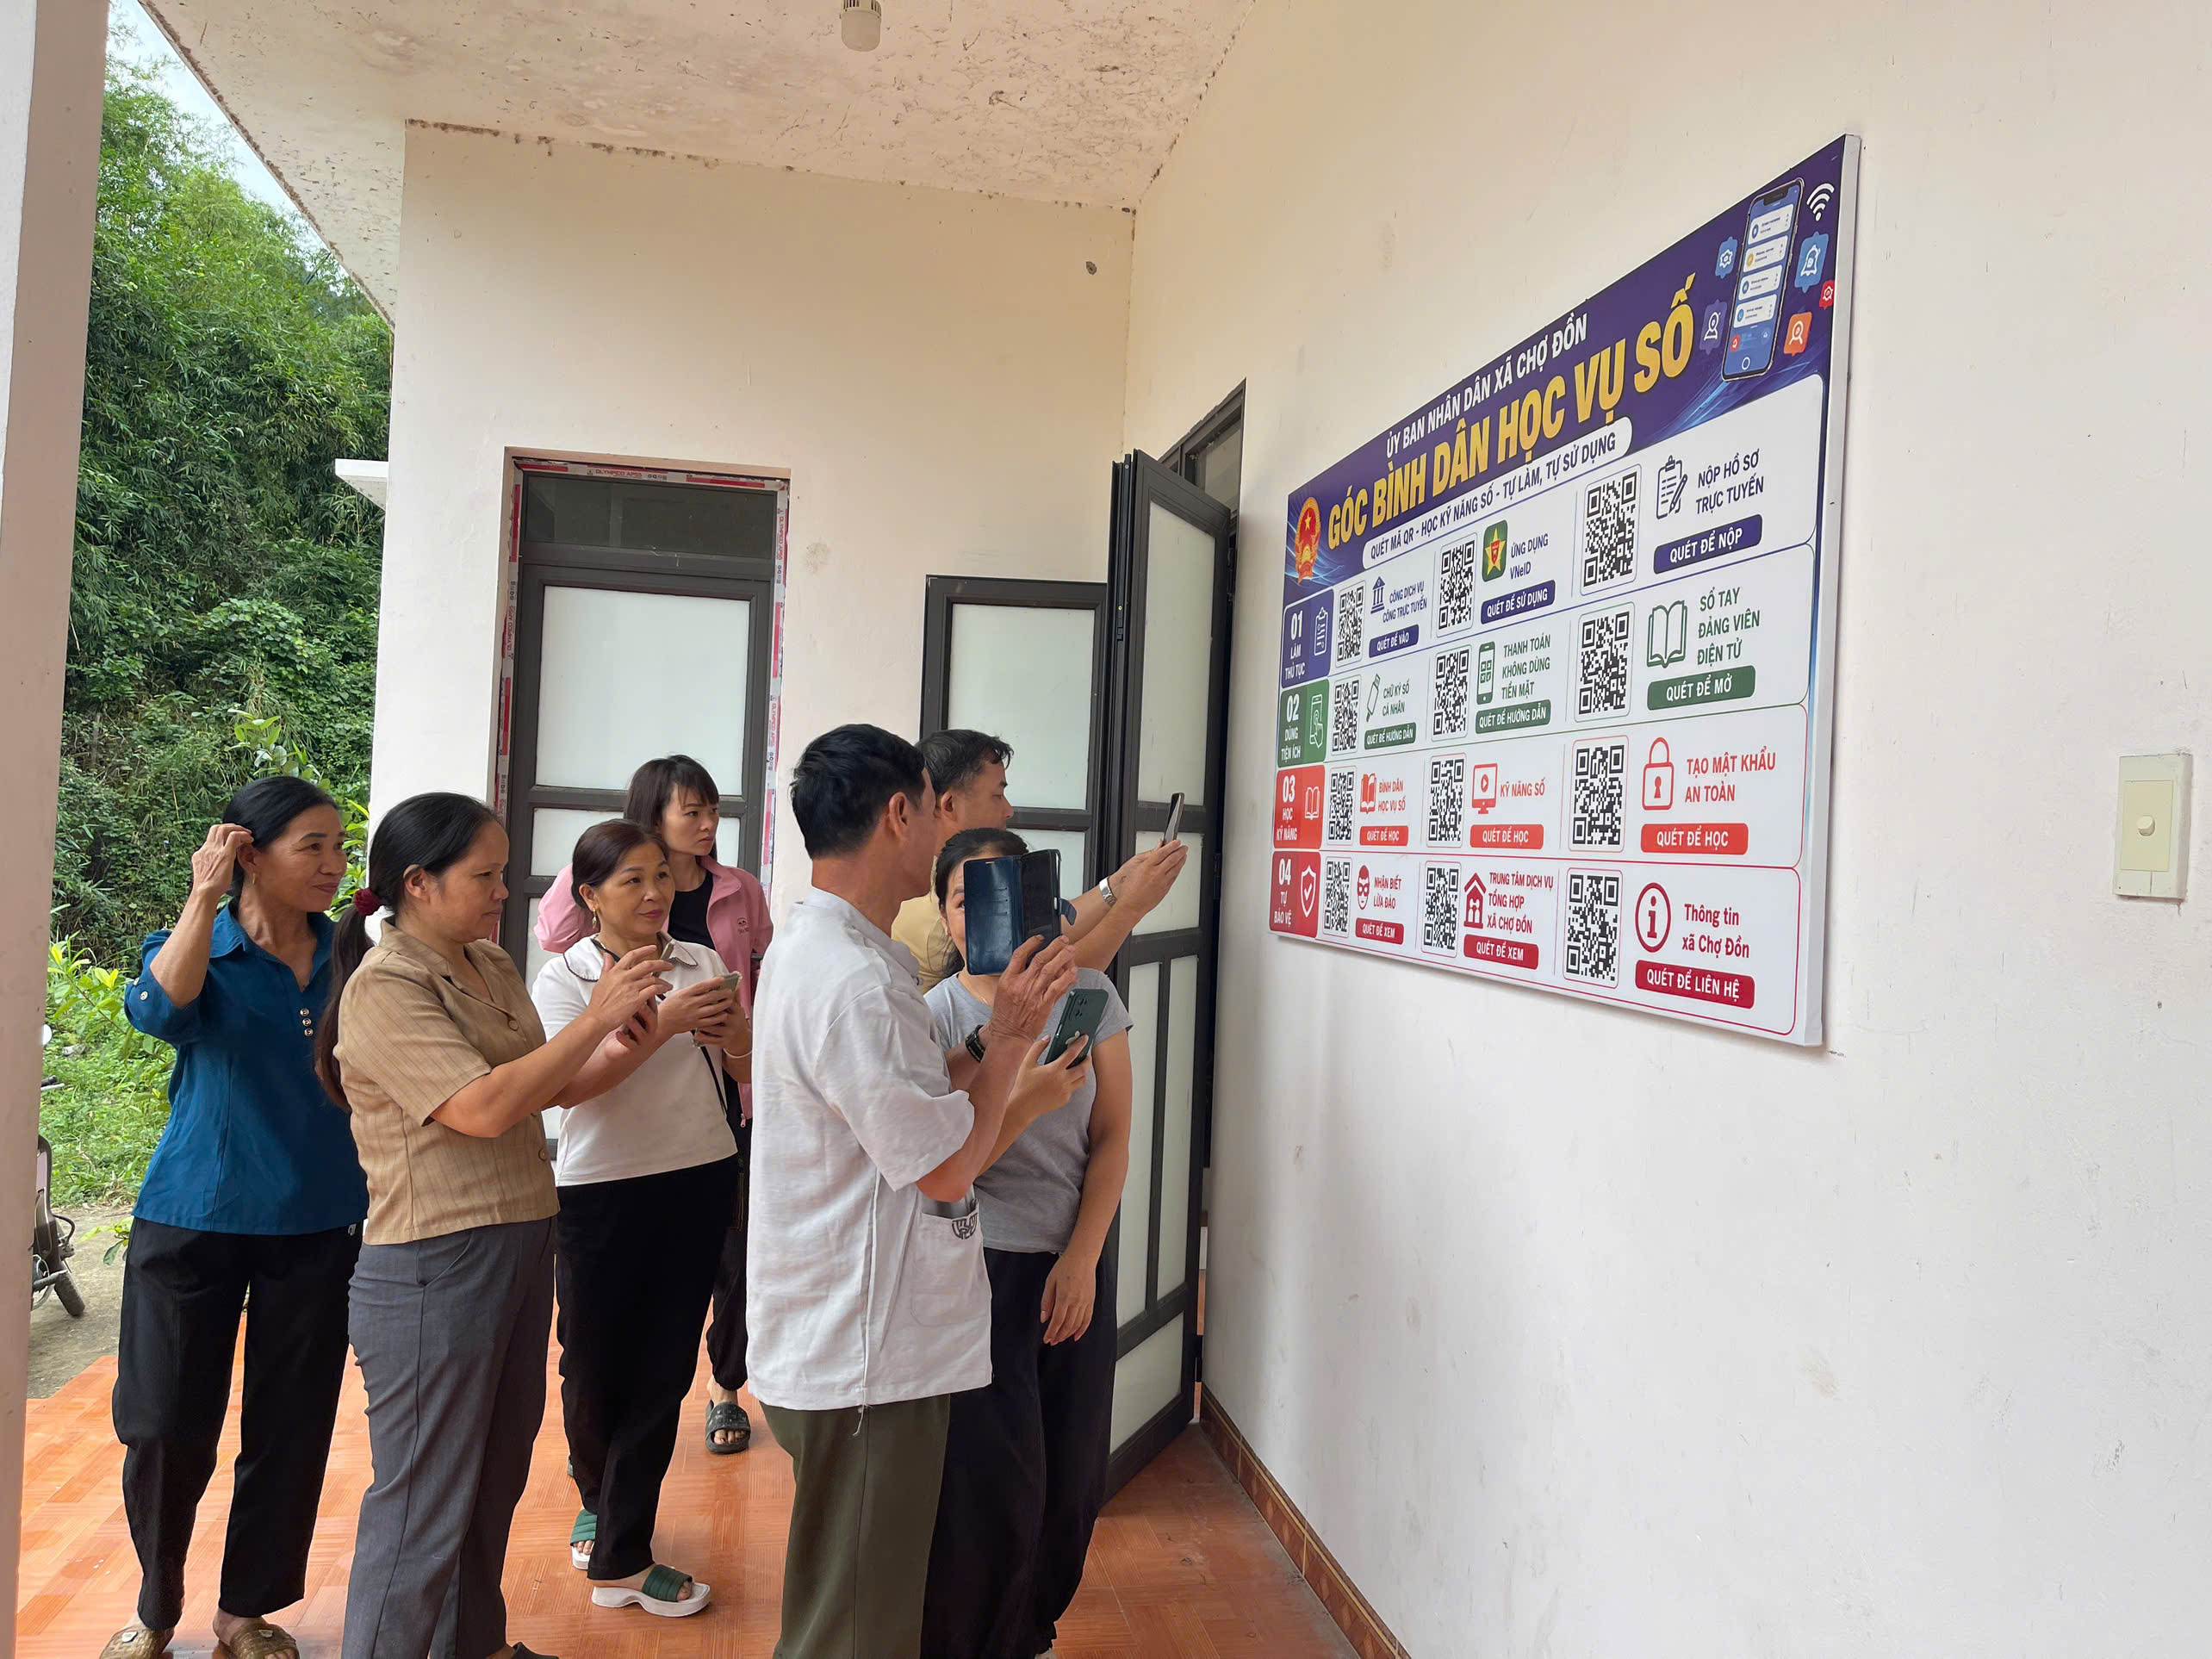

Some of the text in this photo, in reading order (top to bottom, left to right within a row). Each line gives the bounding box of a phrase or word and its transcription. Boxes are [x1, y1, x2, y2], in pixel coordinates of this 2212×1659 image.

[1386, 312, 1588, 458] ỦY BAN NHÂN DÂN XÃ CHỢ ĐỒN
[1328, 272, 1696, 550] GÓC BÌNH DÂN HỌC VỤ SỐ
[1698, 449, 1760, 488] NỘP HỒ SƠ
[1370, 537, 1389, 560] QUÉT
[1390, 527, 1401, 552] MÃ
[1403, 527, 1414, 544] QR
[1421, 515, 1438, 537] HỌC
[1439, 506, 1451, 527] KỸ
[1453, 497, 1478, 522] NĂNG
[1481, 482, 1494, 509] SỐ
[1503, 479, 1517, 503] TỰ
[1518, 468, 1543, 493] LÀM,
[1546, 459, 1562, 482] TỰ
[1563, 444, 1580, 471] SỬ
[1581, 435, 1616, 463] DỤNG
[1696, 474, 1764, 514] TRỰC TUYẾN
[1527, 533, 1549, 553] DỤNG
[1669, 527, 1743, 563] QUÉT ĐỂ NỘP
[1510, 562, 1532, 580] VNeID
[1487, 587, 1548, 618] QUÉT ĐỂ SỬ DỤNG
[1699, 587, 1740, 612] SỔ TAY
[1290, 610, 1303, 640] 01
[1698, 608, 1761, 639] ĐẢNG VIÊN
[1504, 632, 1550, 658] THANH TOÁN
[1697, 637, 1743, 667] ĐIỆN TỬ
[1502, 656, 1550, 680] KHÔNG DÙNG
[1519, 680, 1534, 699] MẶT
[1666, 673, 1733, 701] QUÉT ĐỂ MỞ
[1286, 693, 1300, 723] 02
[1479, 702, 1546, 729] QUÉT ĐỂ HƯỚNG DẪN
[1687, 745, 1776, 779] TẠO MẬT KHẨU
[1283, 774, 1296, 803] 03
[1500, 777, 1545, 797] KỸ NĂNG SỐ
[1685, 780, 1736, 803] AN TOÀN
[1482, 825, 1529, 846] QUÉT ĐỂ HỌC
[1656, 825, 1729, 851] QUÉT ĐỂ HỌC
[1278, 858, 1291, 885] 04
[1489, 871, 1554, 892] TRUNG TÂM DỊCH VỤ
[1488, 889, 1525, 911] TỔNG HỢP
[1487, 913, 1532, 934] XÃ CHỢ ĐỒN
[1684, 904, 1739, 928] Thông tin
[1476, 941, 1524, 961] QUÉT ĐỂ XEM
[1682, 933, 1749, 959] xã Chợ Đồn
[1647, 967, 1740, 1002] QUÉT ĐỂ LIÊN HỆ
